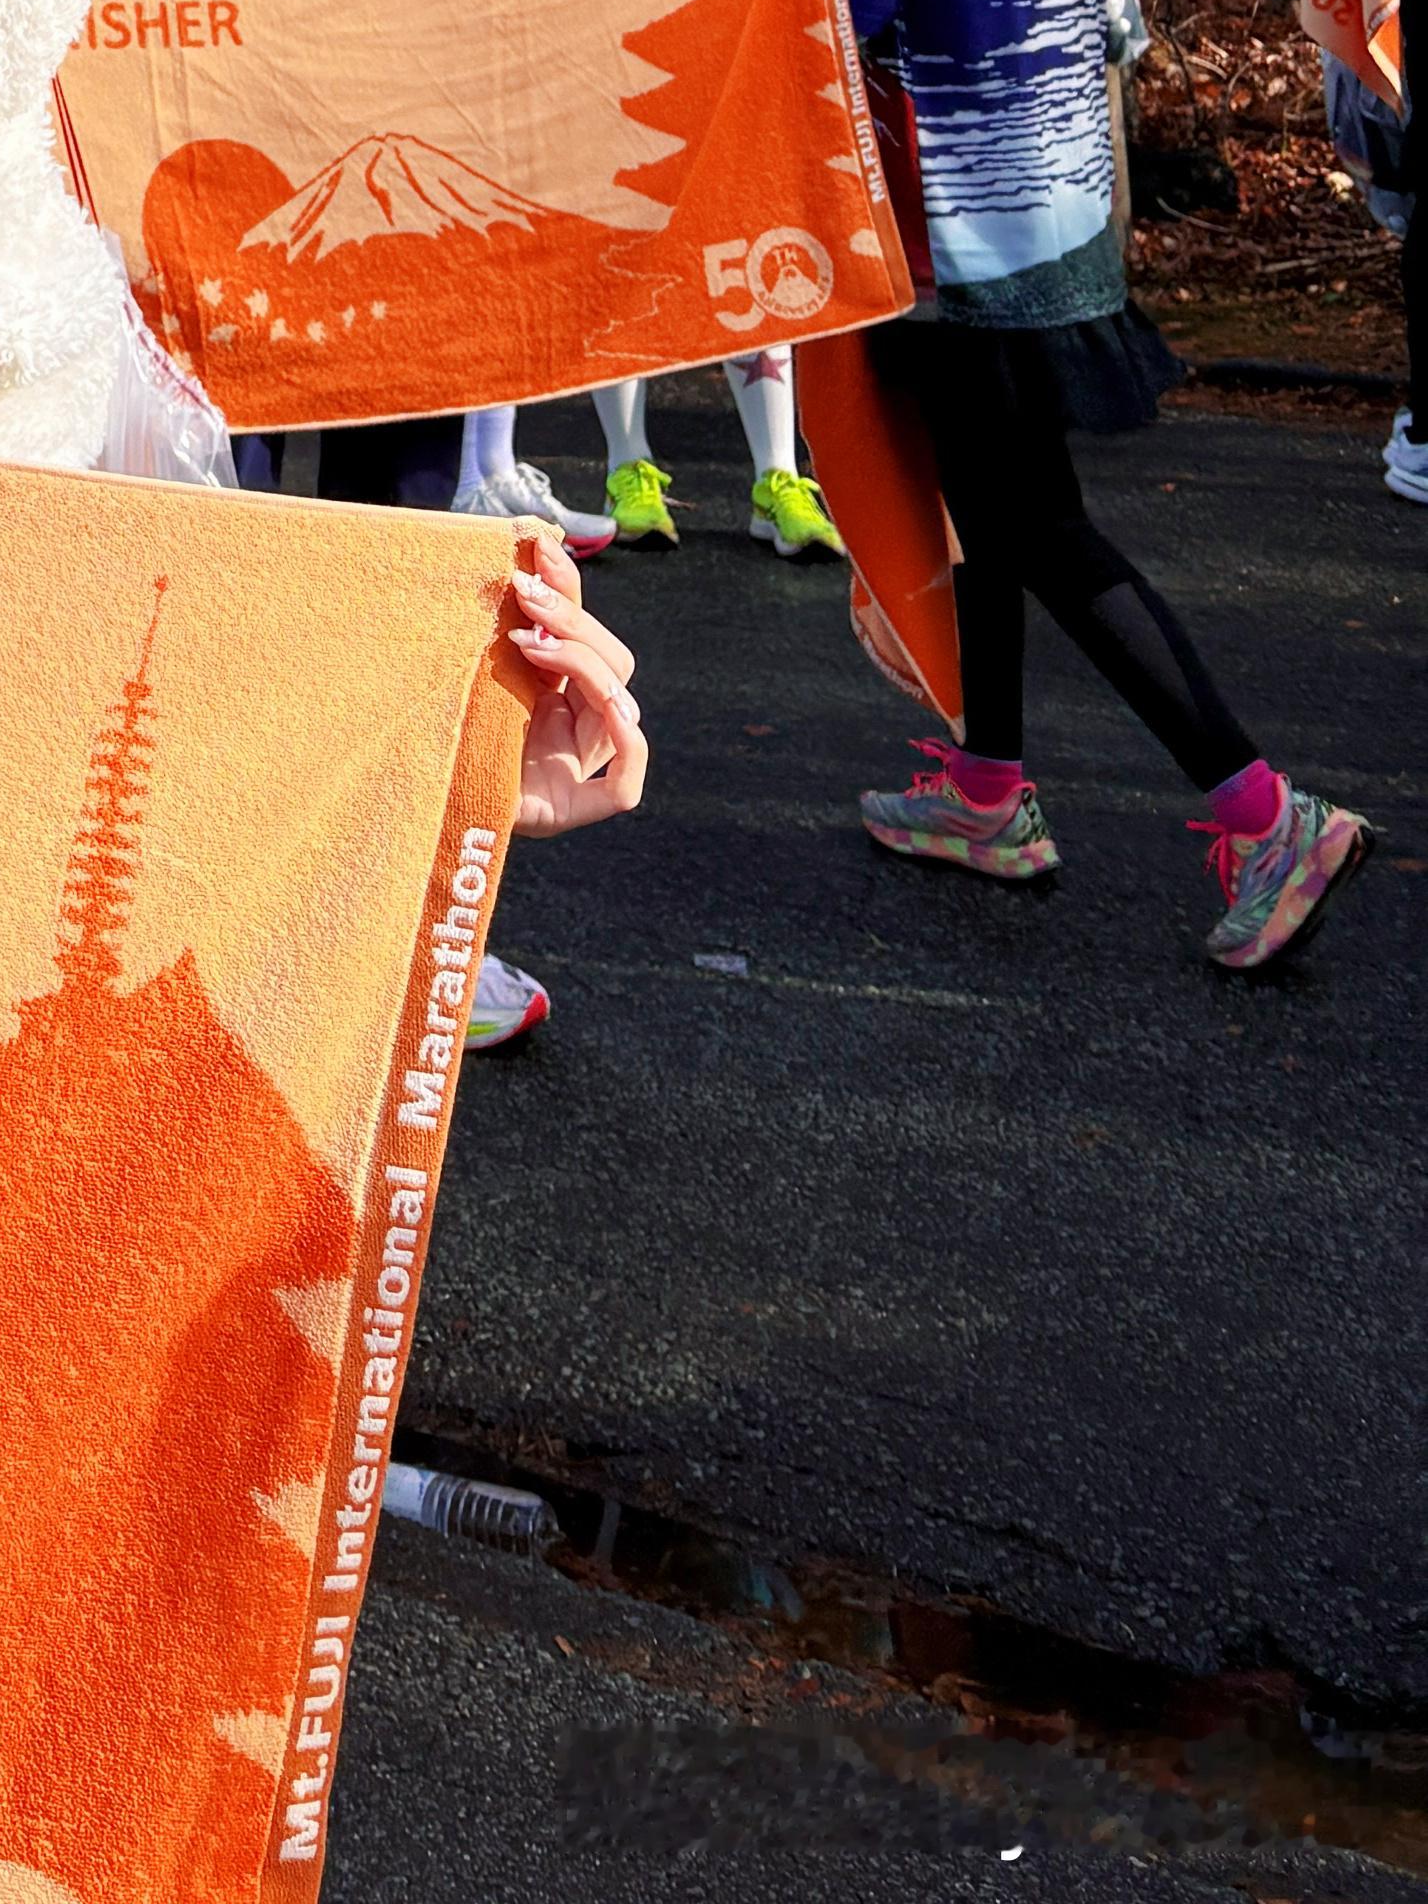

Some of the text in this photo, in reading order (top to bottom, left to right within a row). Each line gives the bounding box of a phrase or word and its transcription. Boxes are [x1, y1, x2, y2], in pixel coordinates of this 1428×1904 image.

[69, 0, 243, 50] ISHER
[322, 1165, 430, 1593] International
[399, 826, 496, 1132] Marathon
